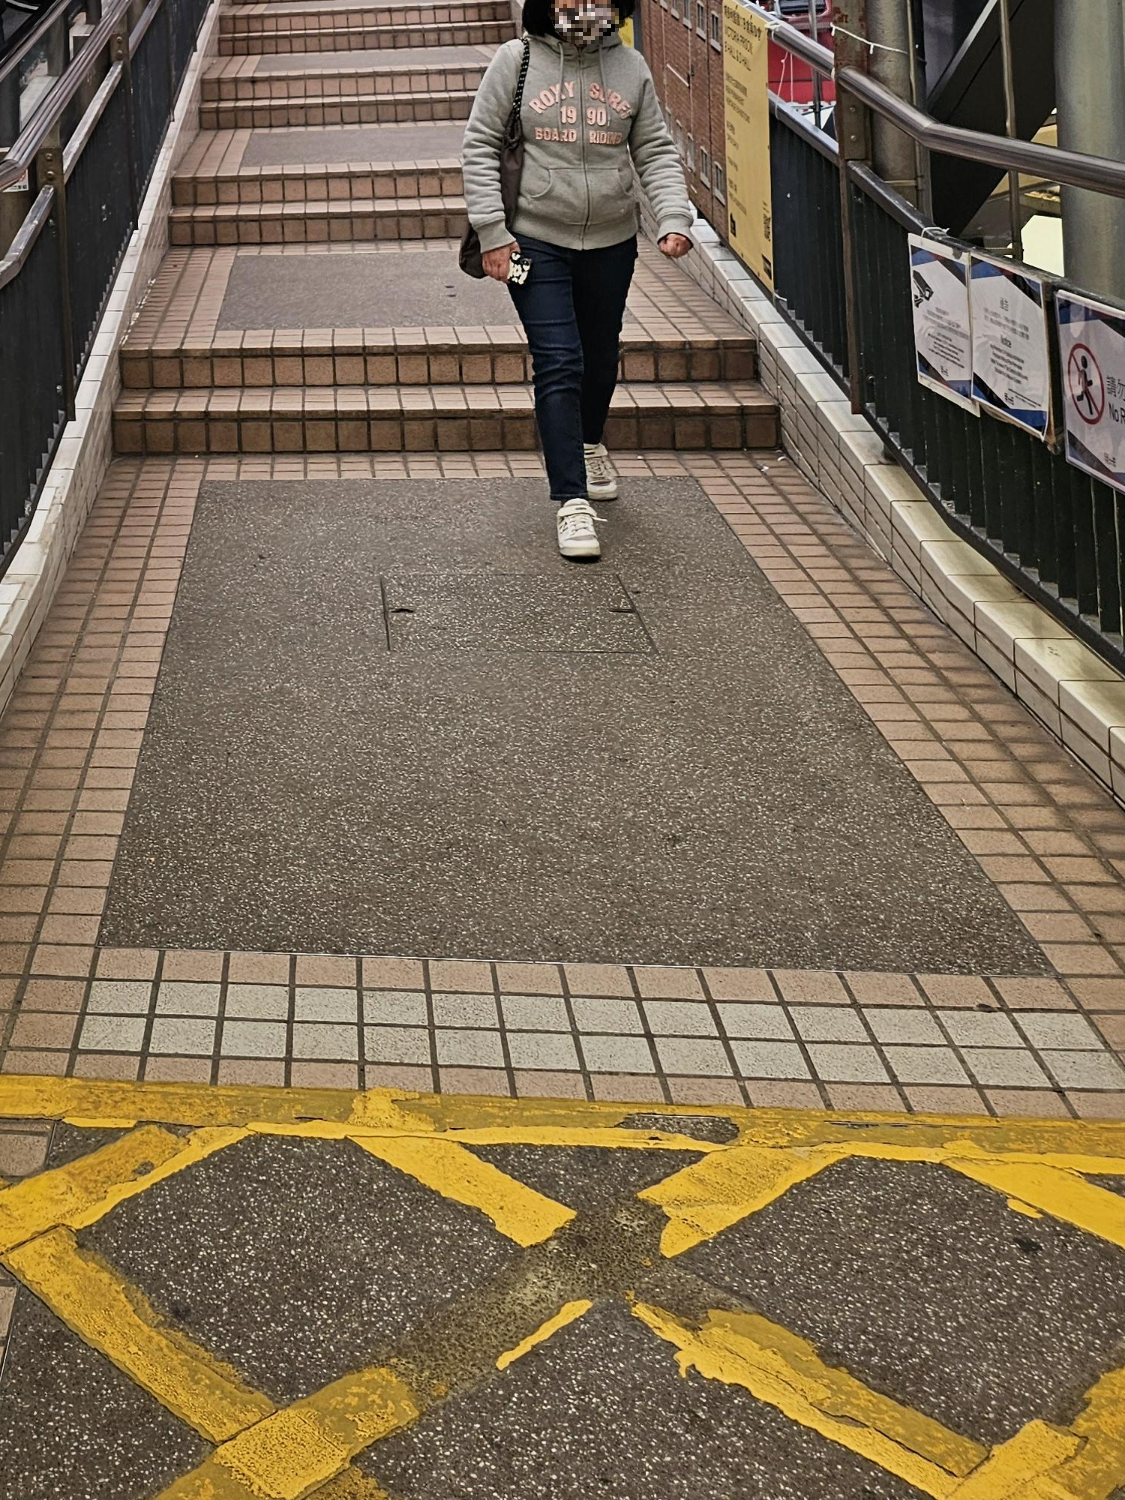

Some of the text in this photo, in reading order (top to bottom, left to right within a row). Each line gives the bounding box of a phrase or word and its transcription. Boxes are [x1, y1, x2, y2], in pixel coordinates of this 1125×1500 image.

[529, 81, 574, 114] ROXY
[560, 105, 607, 125] 19 90
[535, 127, 577, 142] BOARD
[1108, 402, 1119, 422] No
